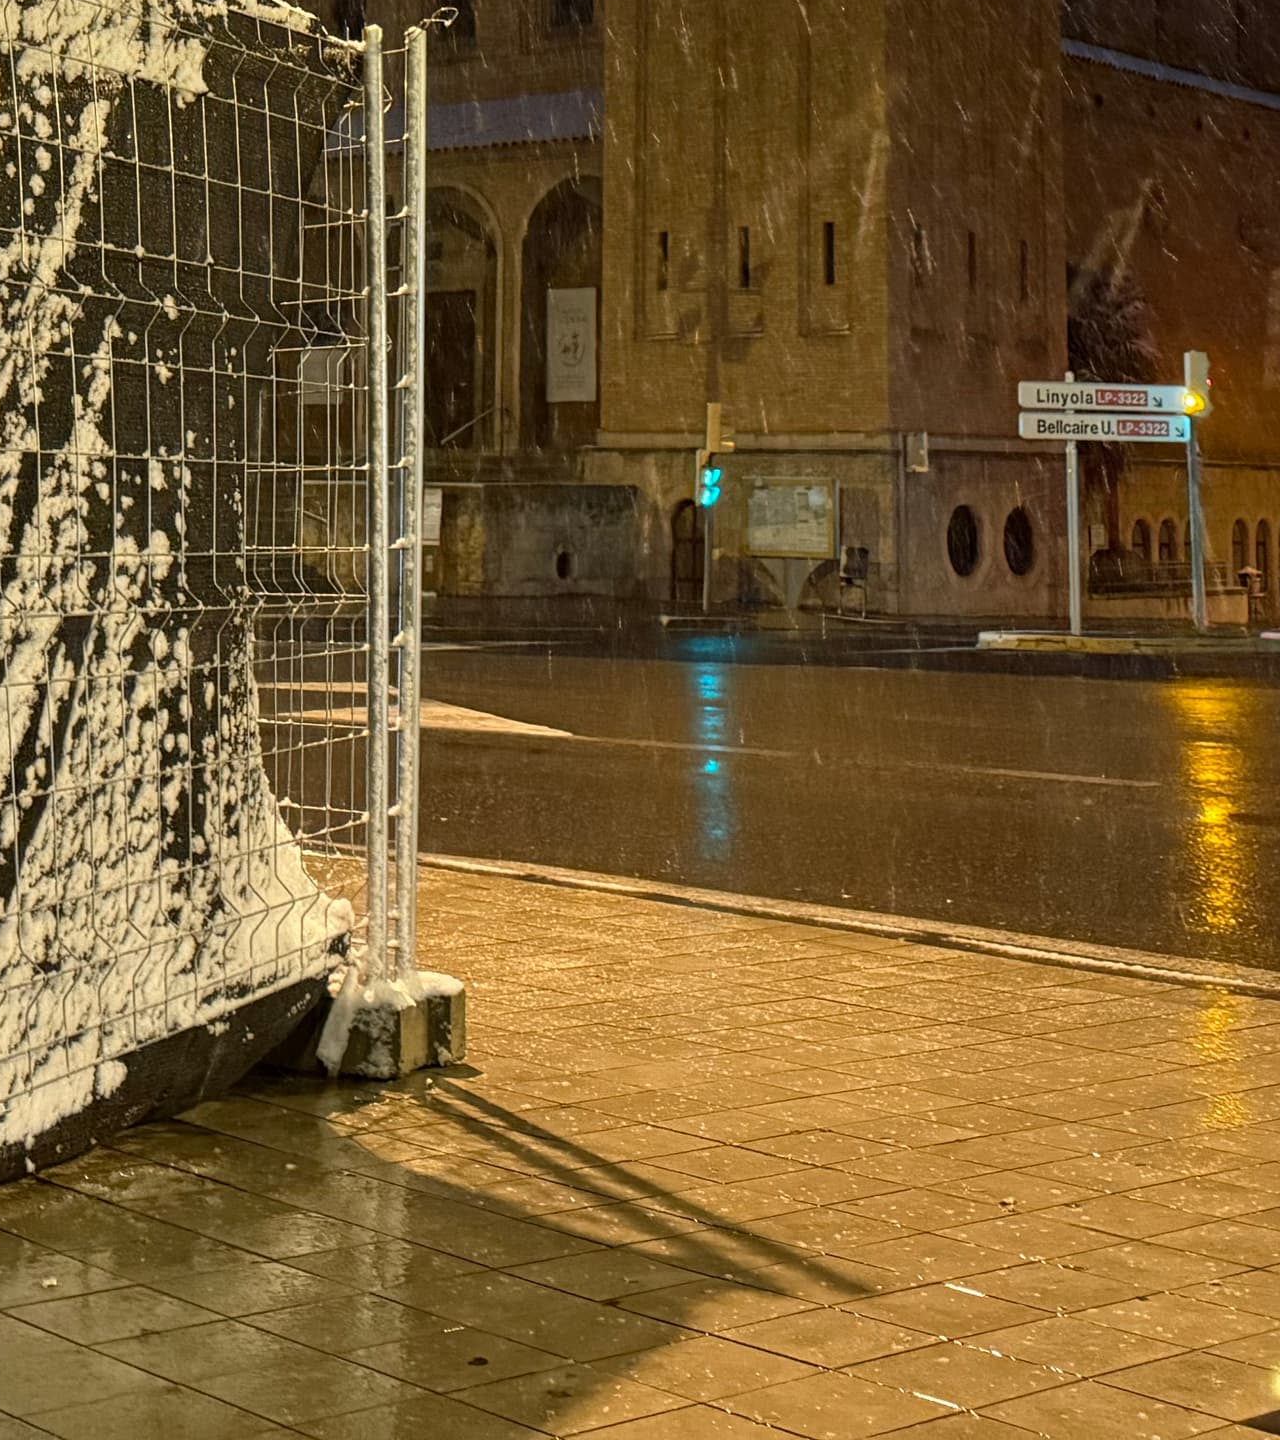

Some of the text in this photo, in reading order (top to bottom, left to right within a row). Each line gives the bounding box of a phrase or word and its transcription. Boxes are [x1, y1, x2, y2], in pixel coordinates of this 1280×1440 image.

[1036, 389, 1147, 406] Linyola LP-3322
[1037, 419, 1168, 436] Bellcaire U. LP-3322
